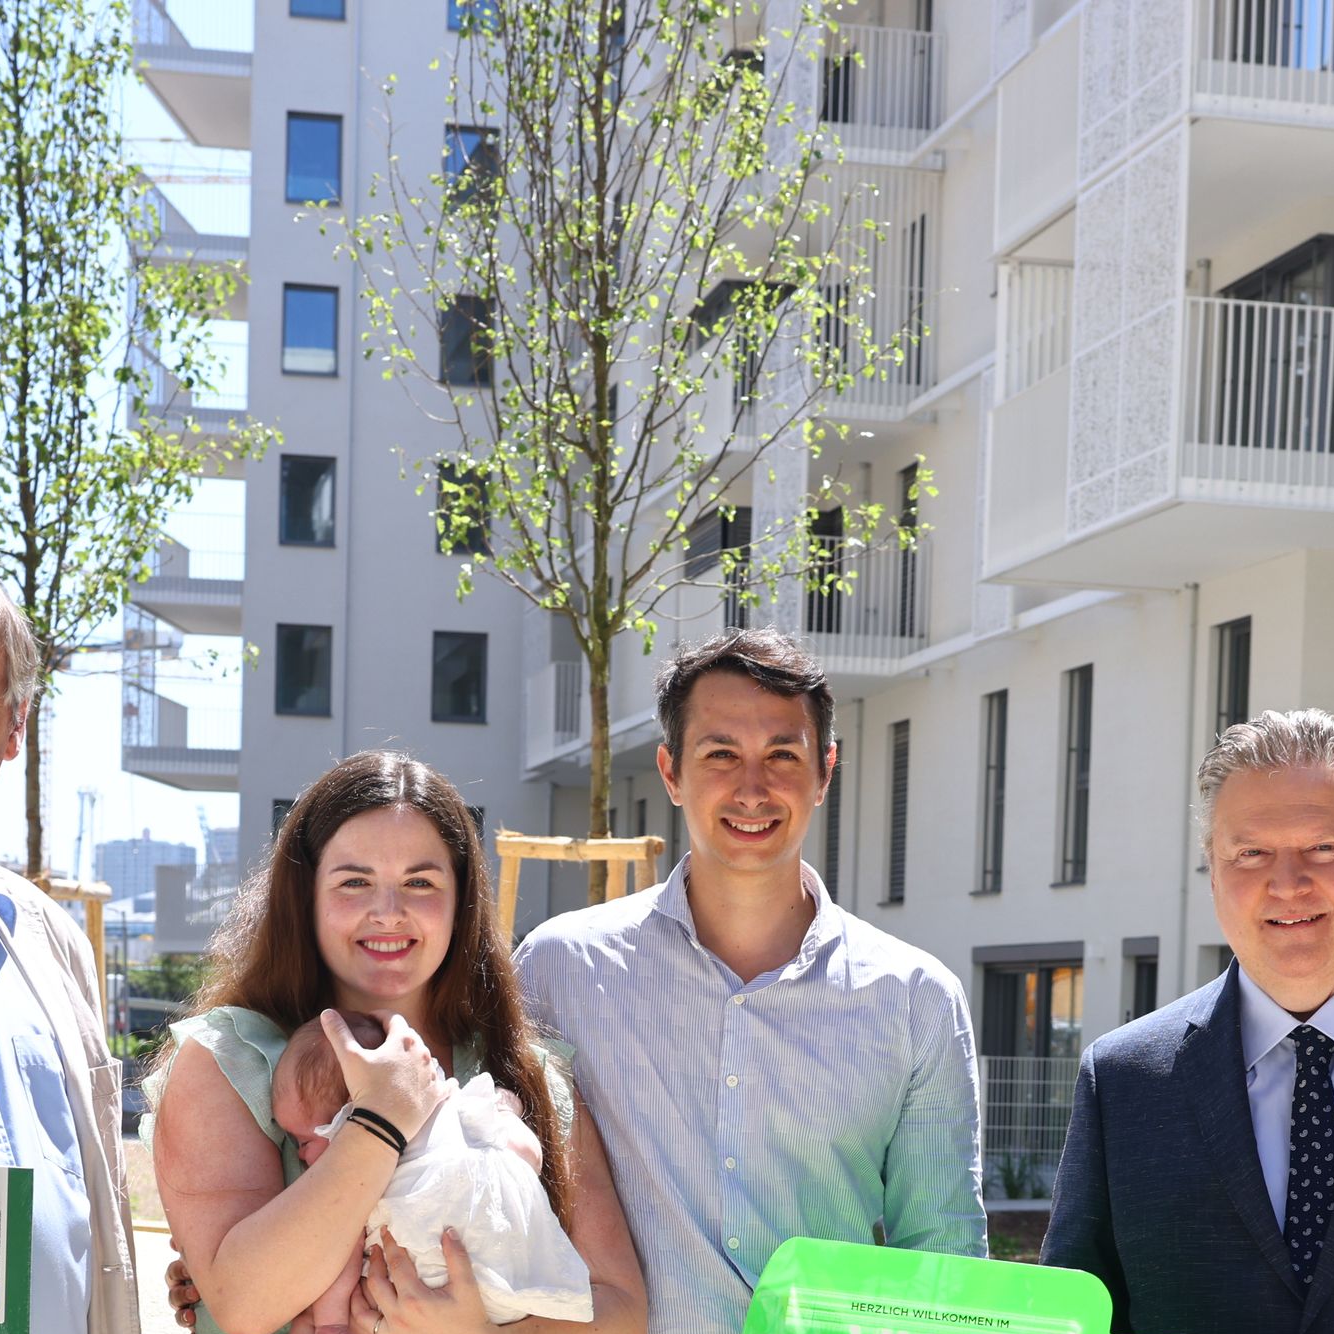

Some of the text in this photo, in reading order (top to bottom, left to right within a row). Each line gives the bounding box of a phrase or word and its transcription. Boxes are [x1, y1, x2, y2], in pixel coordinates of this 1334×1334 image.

[851, 1302, 1010, 1328] HERZLICH WILLKOMMEN IM
